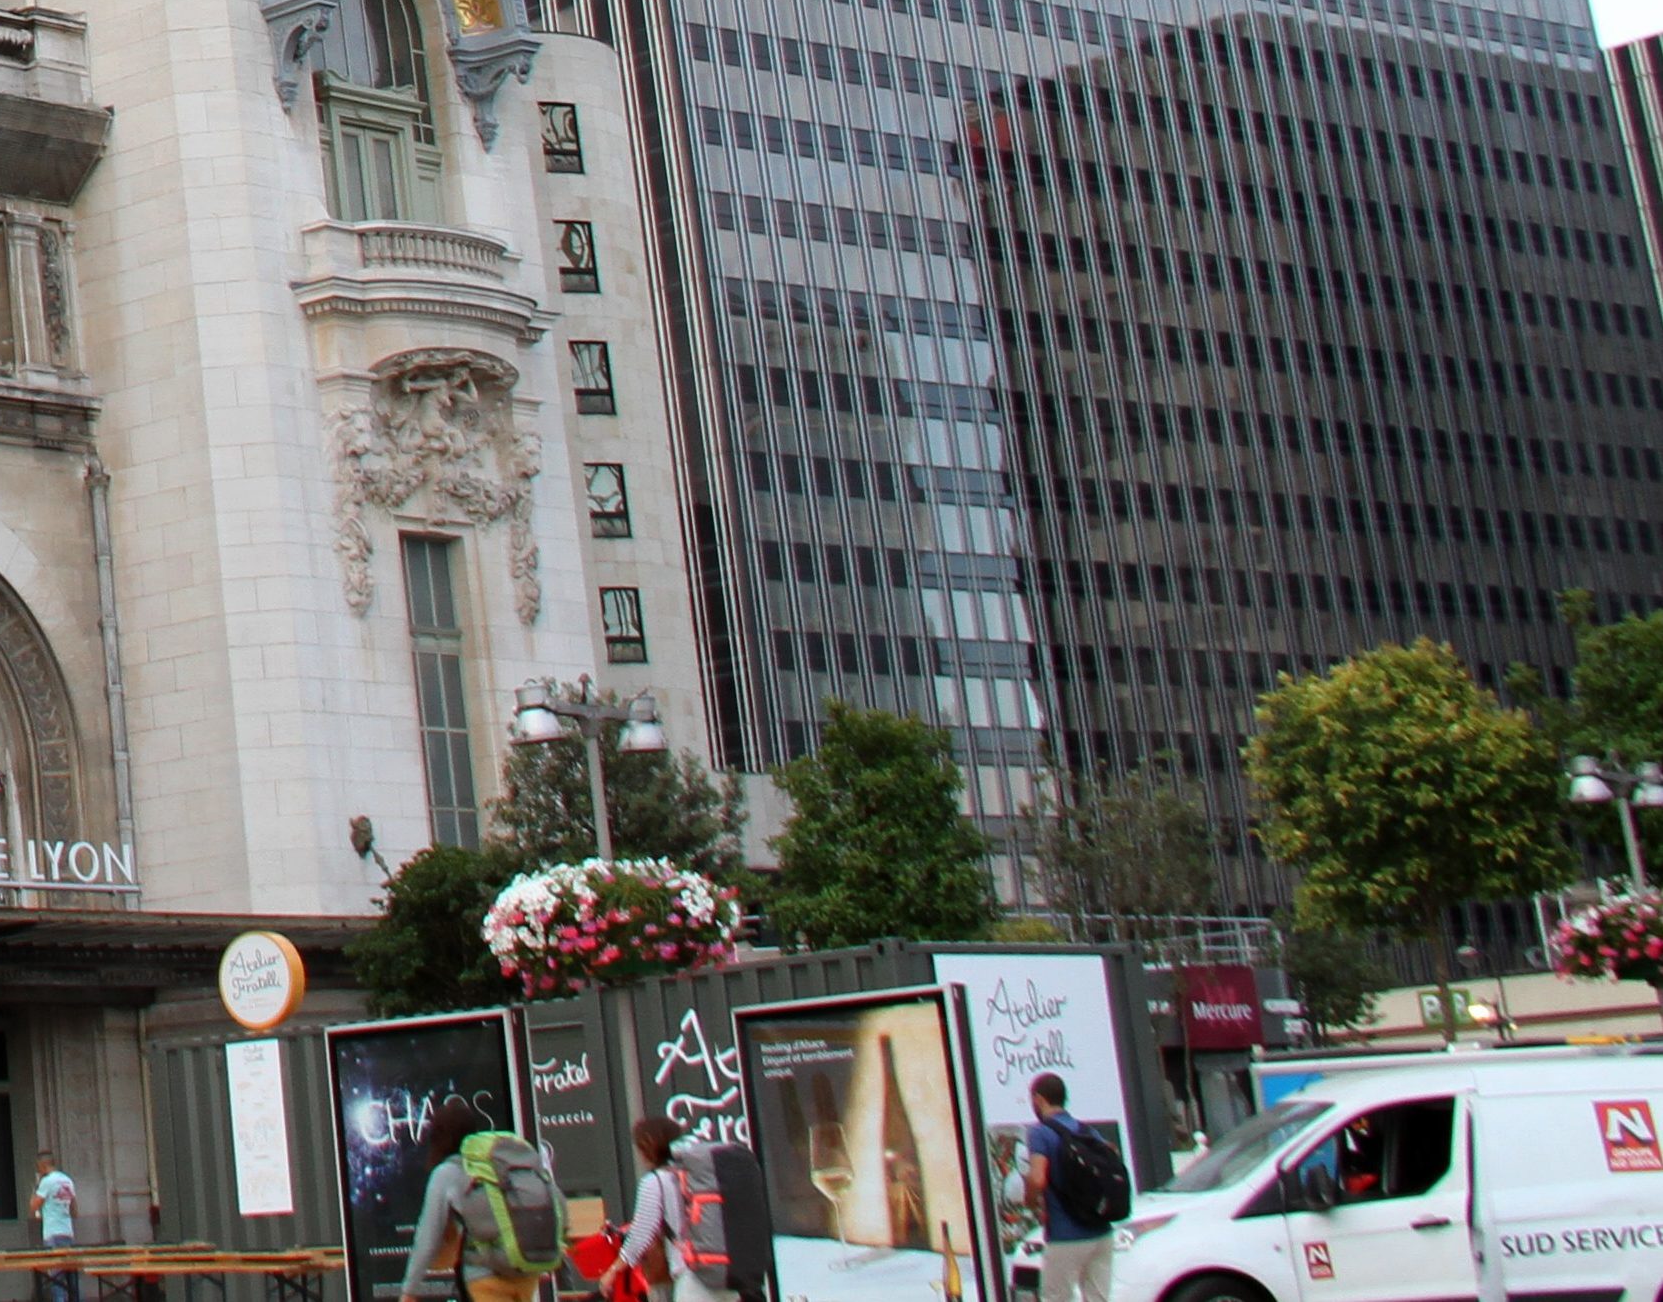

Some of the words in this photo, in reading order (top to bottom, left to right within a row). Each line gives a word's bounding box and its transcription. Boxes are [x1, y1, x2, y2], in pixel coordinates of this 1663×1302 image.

[27, 839, 135, 885] LYON
[230, 947, 281, 977] Atelier
[231, 968, 283, 1000] Fratelli
[986, 976, 1067, 1035] Atelier
[1191, 1000, 1254, 1021] Mercure
[993, 1029, 1076, 1086] Fratelli
[1605, 1107, 1656, 1143] N
[1500, 1231, 1557, 1259] SUD
